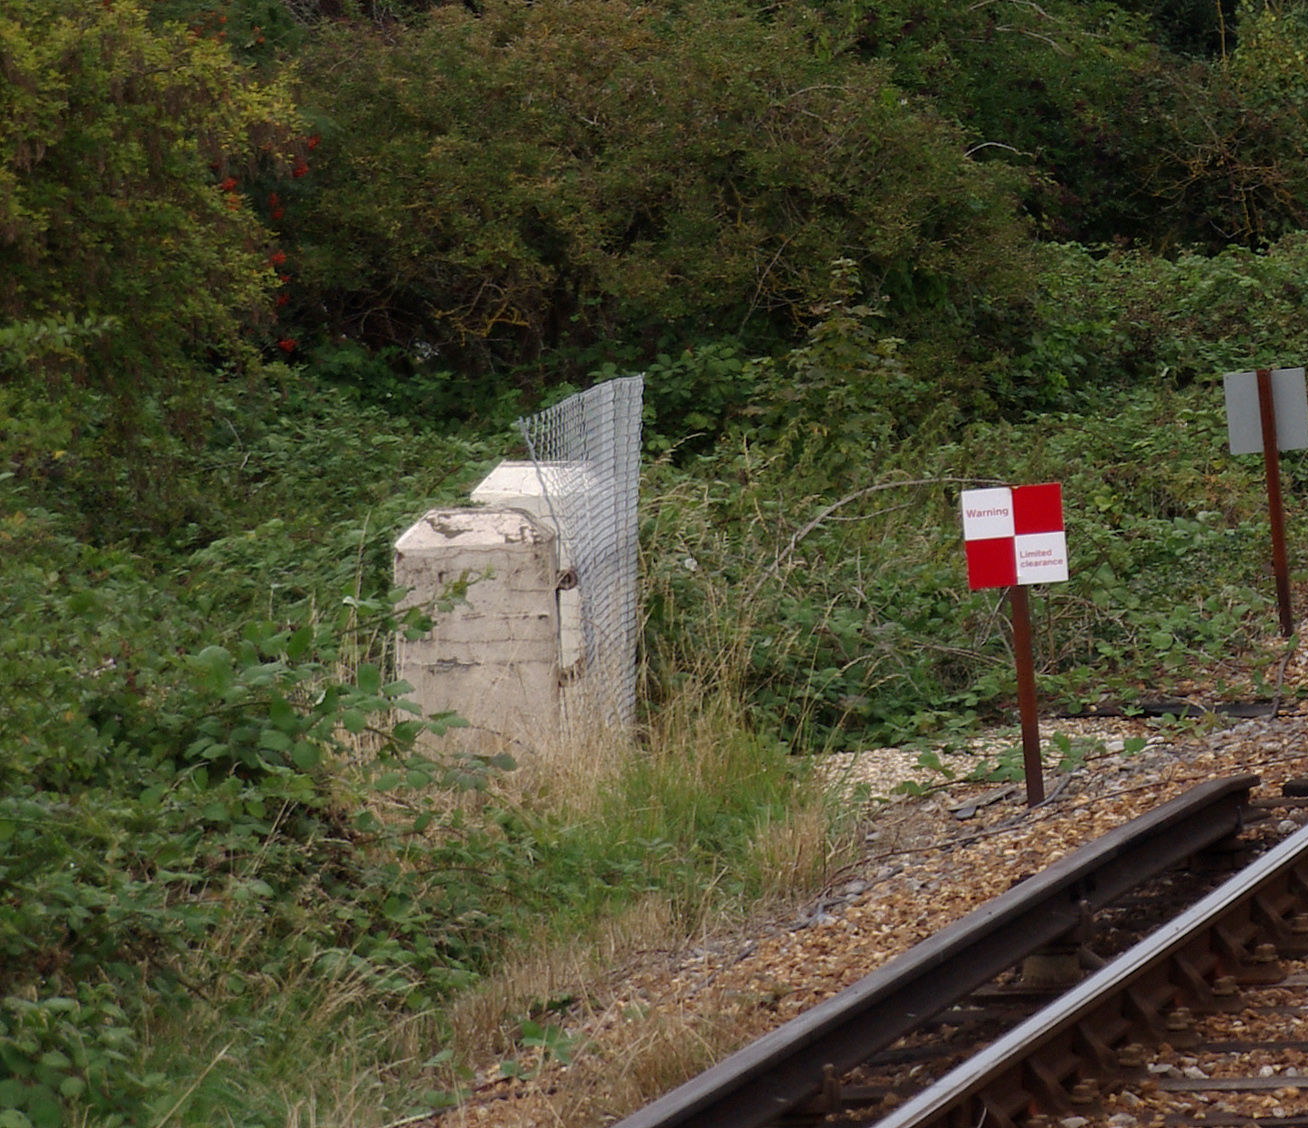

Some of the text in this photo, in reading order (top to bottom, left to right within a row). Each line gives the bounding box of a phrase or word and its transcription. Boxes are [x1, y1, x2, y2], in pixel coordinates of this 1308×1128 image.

[966, 507, 1009, 518] Warning
[1019, 549, 1052, 559] Limited
[1020, 558, 1063, 568] clearance
